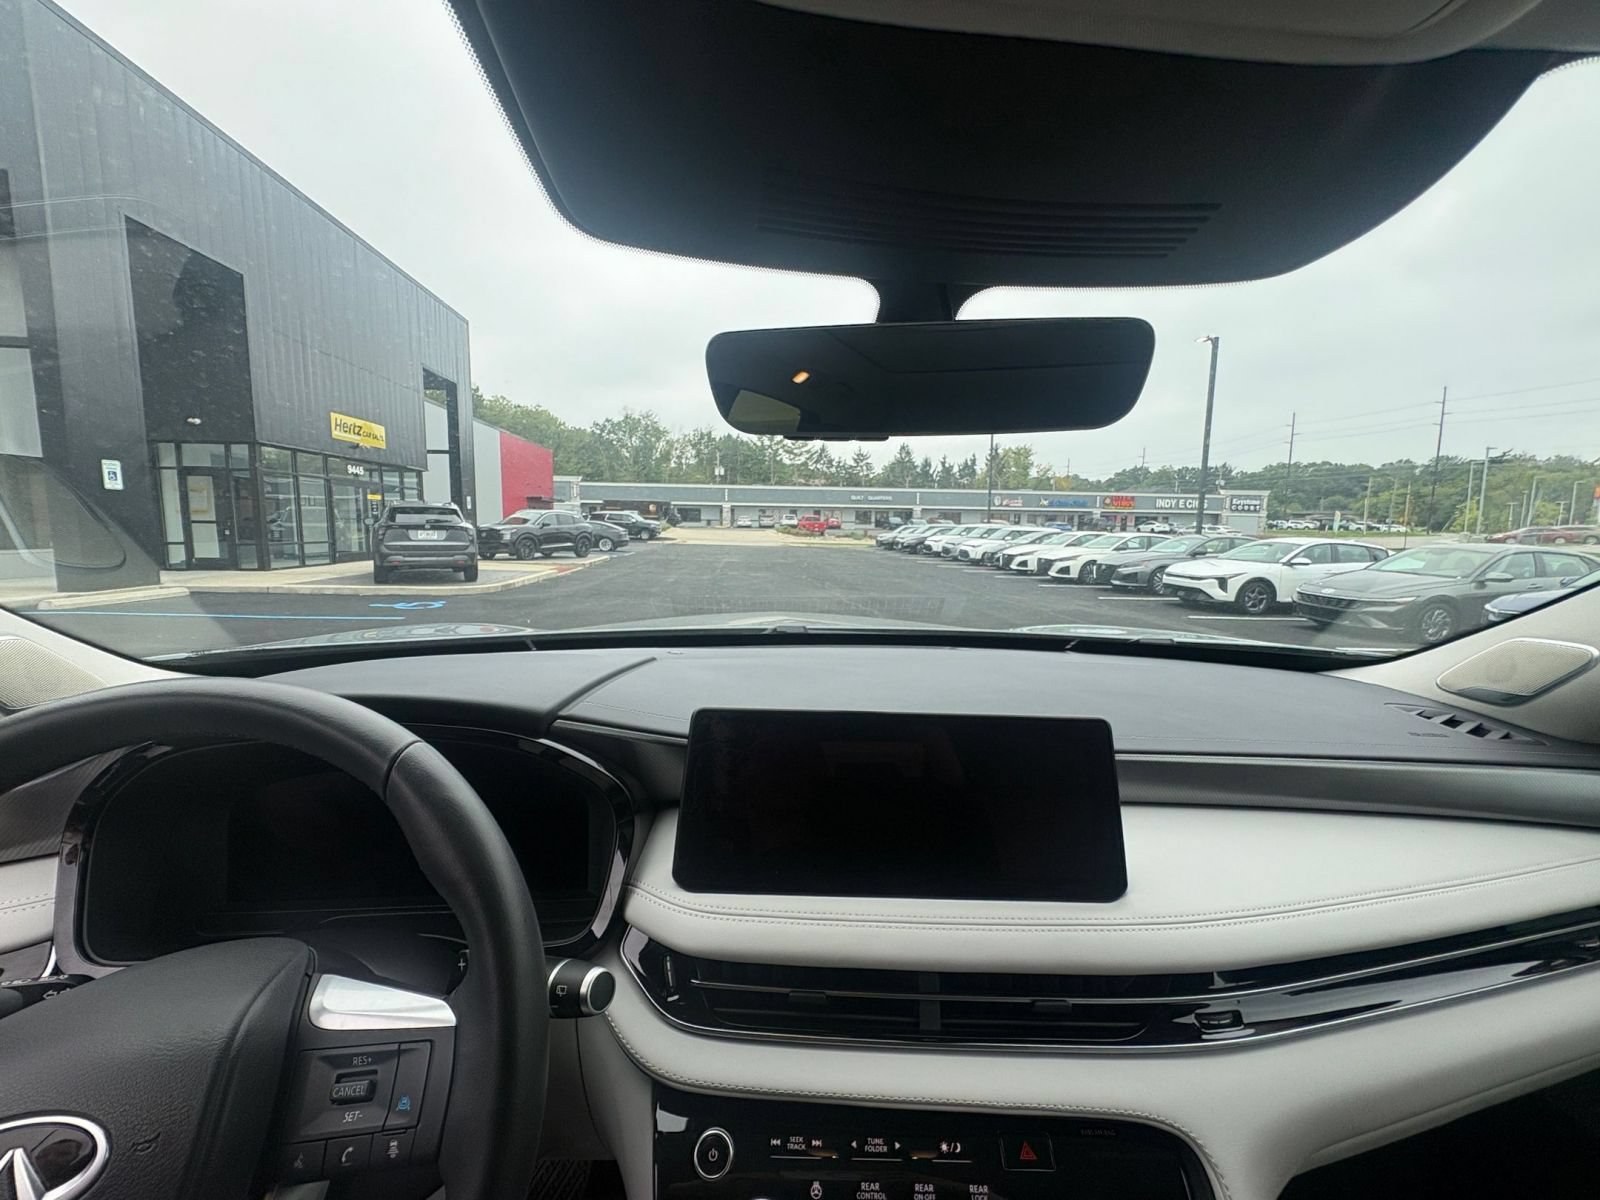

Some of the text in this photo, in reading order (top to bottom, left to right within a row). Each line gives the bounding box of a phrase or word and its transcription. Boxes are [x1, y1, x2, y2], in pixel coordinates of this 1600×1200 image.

[334, 417, 362, 436] Hertz
[347, 464, 364, 475] 9445
[1156, 498, 1177, 508] INDY
[1178, 499, 1185, 508] E
[352, 1055, 372, 1066] RES+
[332, 1085, 364, 1098] CANCEL
[342, 1110, 363, 1123] SET-
[867, 1137, 885, 1145] TUNE
[787, 1143, 807, 1151] TRACK
[864, 1145, 888, 1153] FOLDER
[860, 1182, 880, 1191] REAR
[914, 1183, 934, 1192] REAR
[969, 1184, 989, 1193] REAR
[856, 1191, 887, 1200] CONTROL
